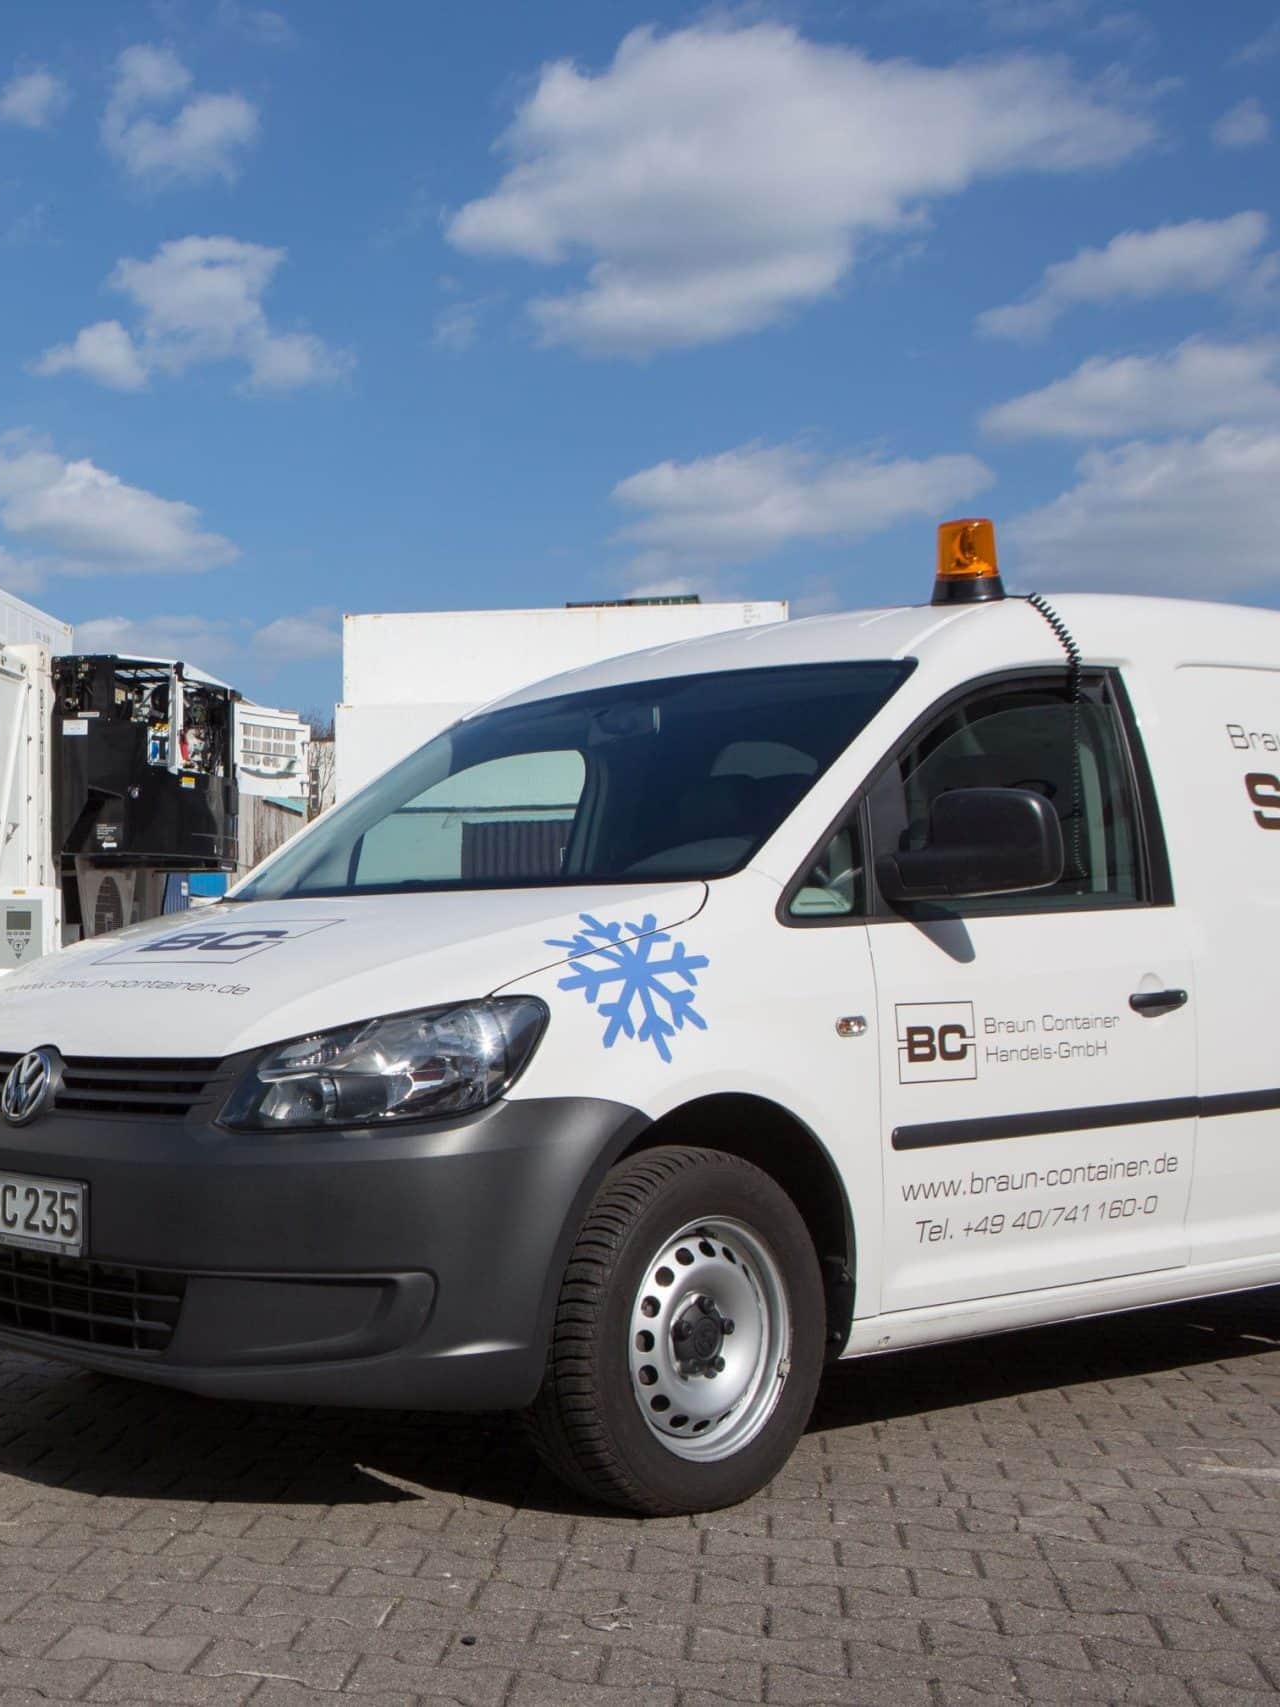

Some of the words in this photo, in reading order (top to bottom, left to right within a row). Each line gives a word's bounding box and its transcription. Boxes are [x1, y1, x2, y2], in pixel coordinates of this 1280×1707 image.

[1226, 723, 1280, 752] Bra
[136, 930, 288, 953] BC
[983, 1016, 1036, 1035] Braun
[1041, 1014, 1120, 1032] Container
[906, 1024, 968, 1063] BC
[985, 1040, 1108, 1064] Handels-GmbH
[901, 1152, 1179, 1202] www.braun-container.de
[24, 1187, 79, 1238] 235
[916, 1218, 953, 1244] Tel.
[963, 1213, 1005, 1238] +49
[1011, 1203, 1091, 1231] 40/741
[1098, 1194, 1159, 1221] 160-0
